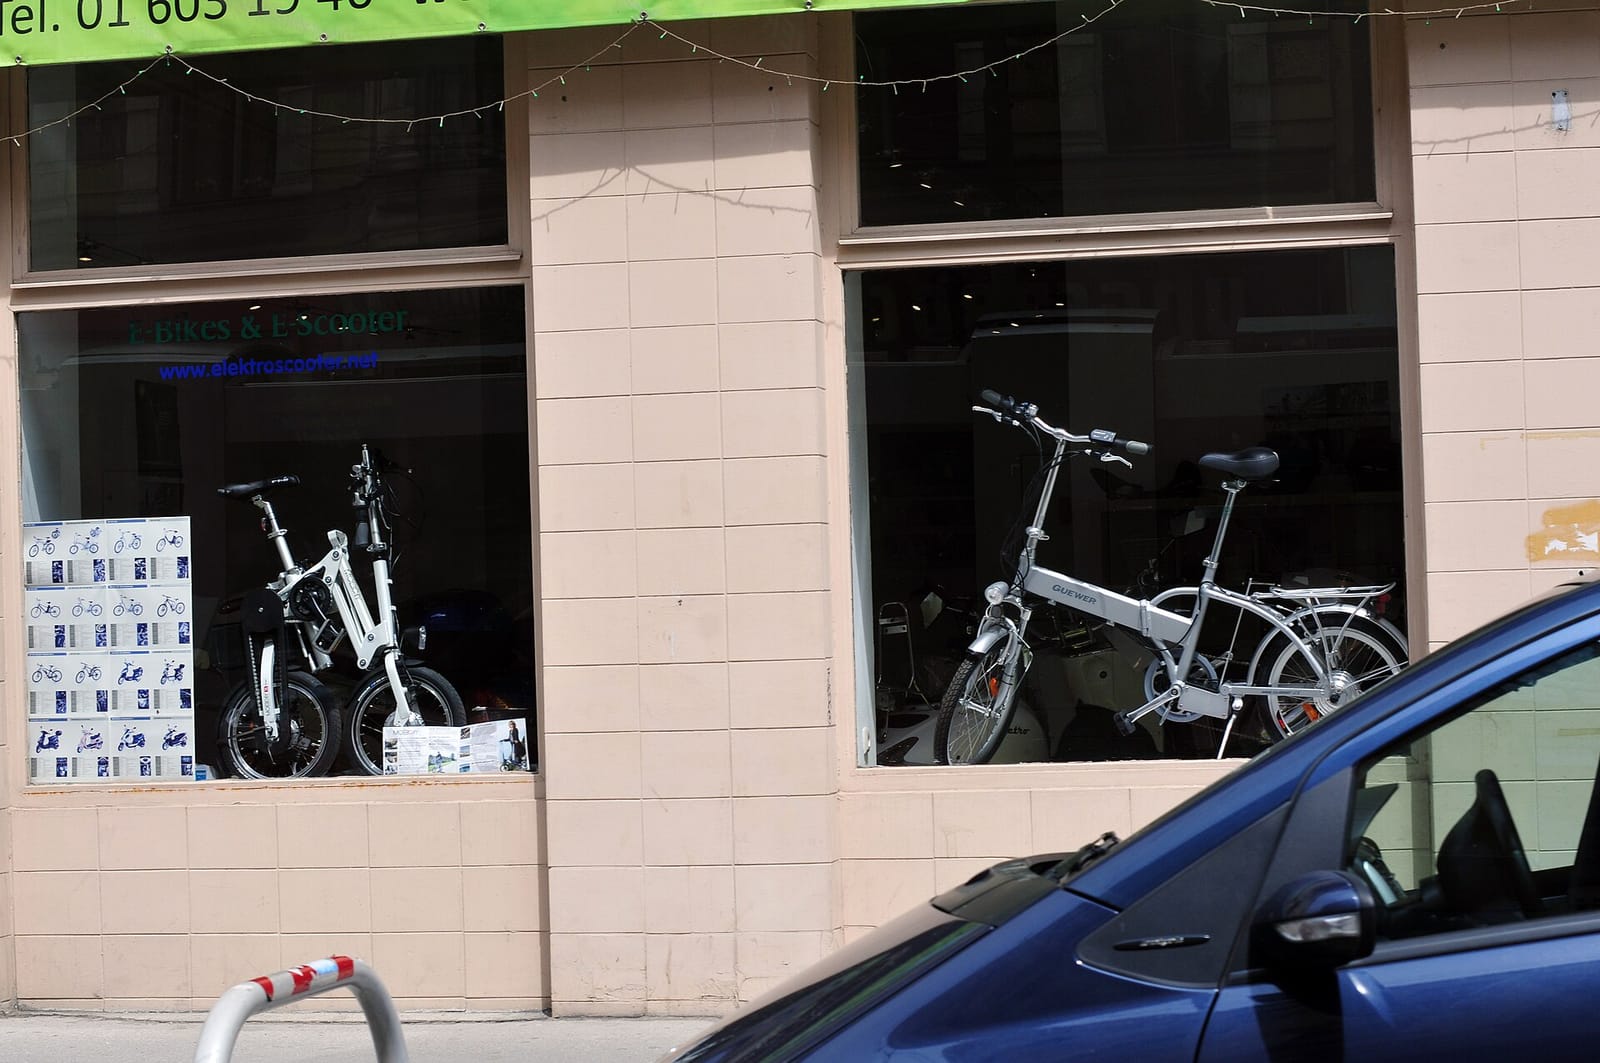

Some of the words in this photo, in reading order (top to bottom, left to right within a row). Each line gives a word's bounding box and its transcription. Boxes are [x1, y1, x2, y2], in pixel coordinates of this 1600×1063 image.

[78, 0, 129, 29] 01
[128, 316, 231, 345] E-Bikes
[240, 315, 261, 340] &
[271, 309, 408, 338] E-Scooter
[159, 351, 380, 380] www.elektroscooter.net
[1052, 584, 1097, 604] GUEWER
